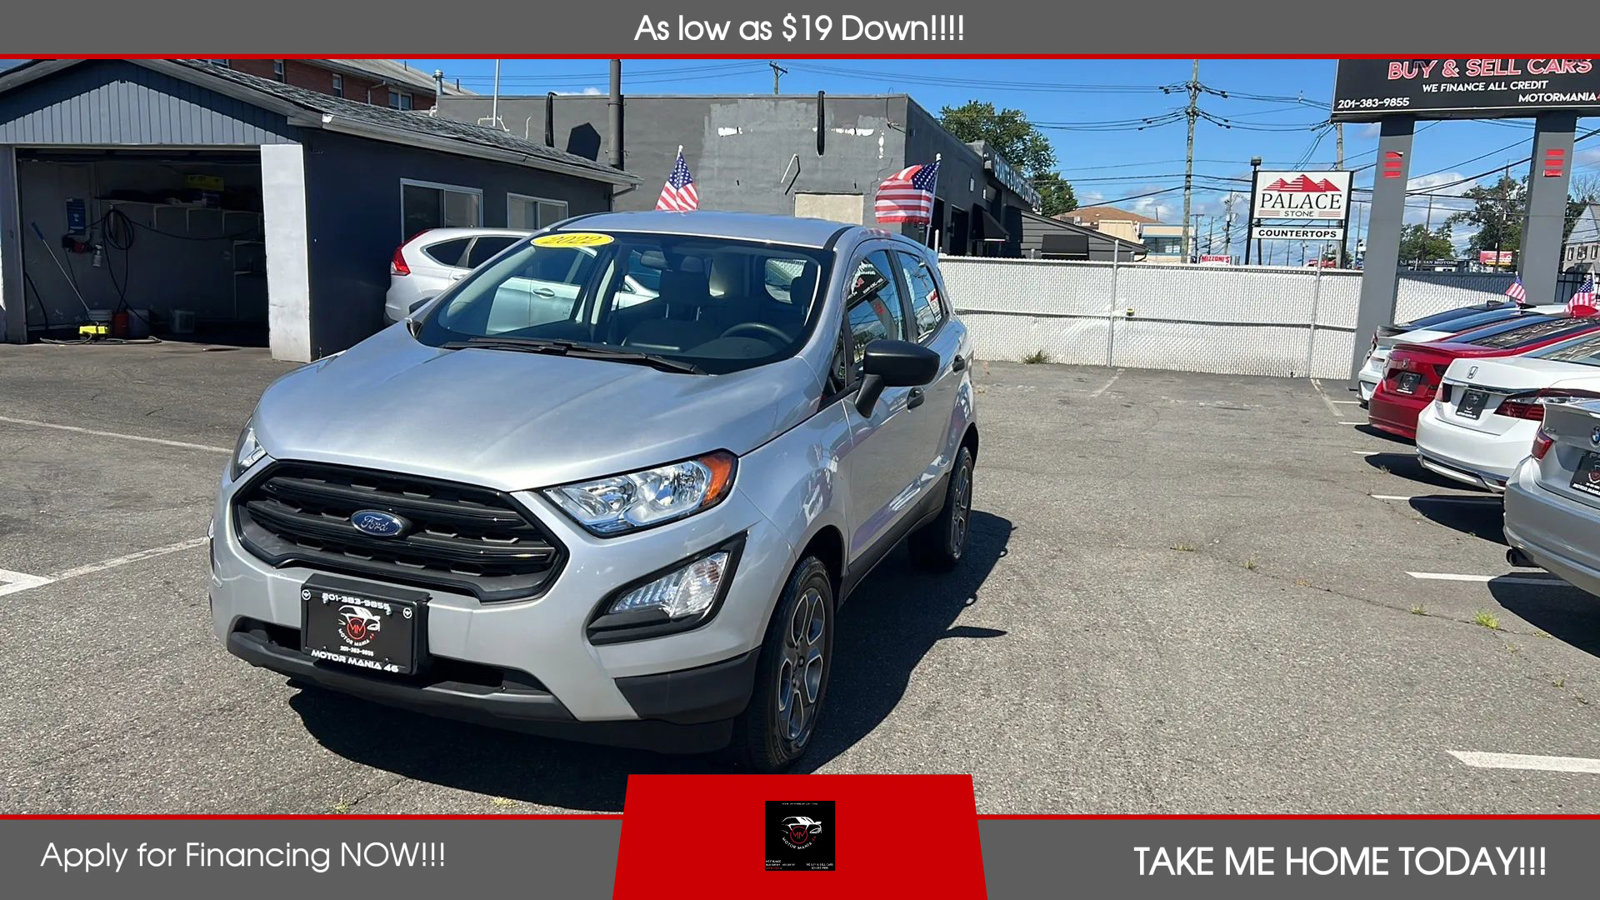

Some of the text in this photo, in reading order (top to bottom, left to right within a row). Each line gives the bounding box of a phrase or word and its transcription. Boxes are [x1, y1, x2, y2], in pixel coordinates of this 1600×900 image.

[1388, 59, 1593, 80] BUY & SELL CARS
[1422, 80, 1549, 93] WE FINANCE ALL CREDIT
[1337, 97, 1410, 109] 201-383-9855
[1260, 193, 1343, 210] PALACE
[1284, 210, 1315, 218] STONE
[541, 236, 603, 244] 2022
[1258, 229, 1337, 238] COUNTERTOPS
[360, 515, 390, 532] Ford
[311, 649, 399, 673] MOTOR MANIA 46
